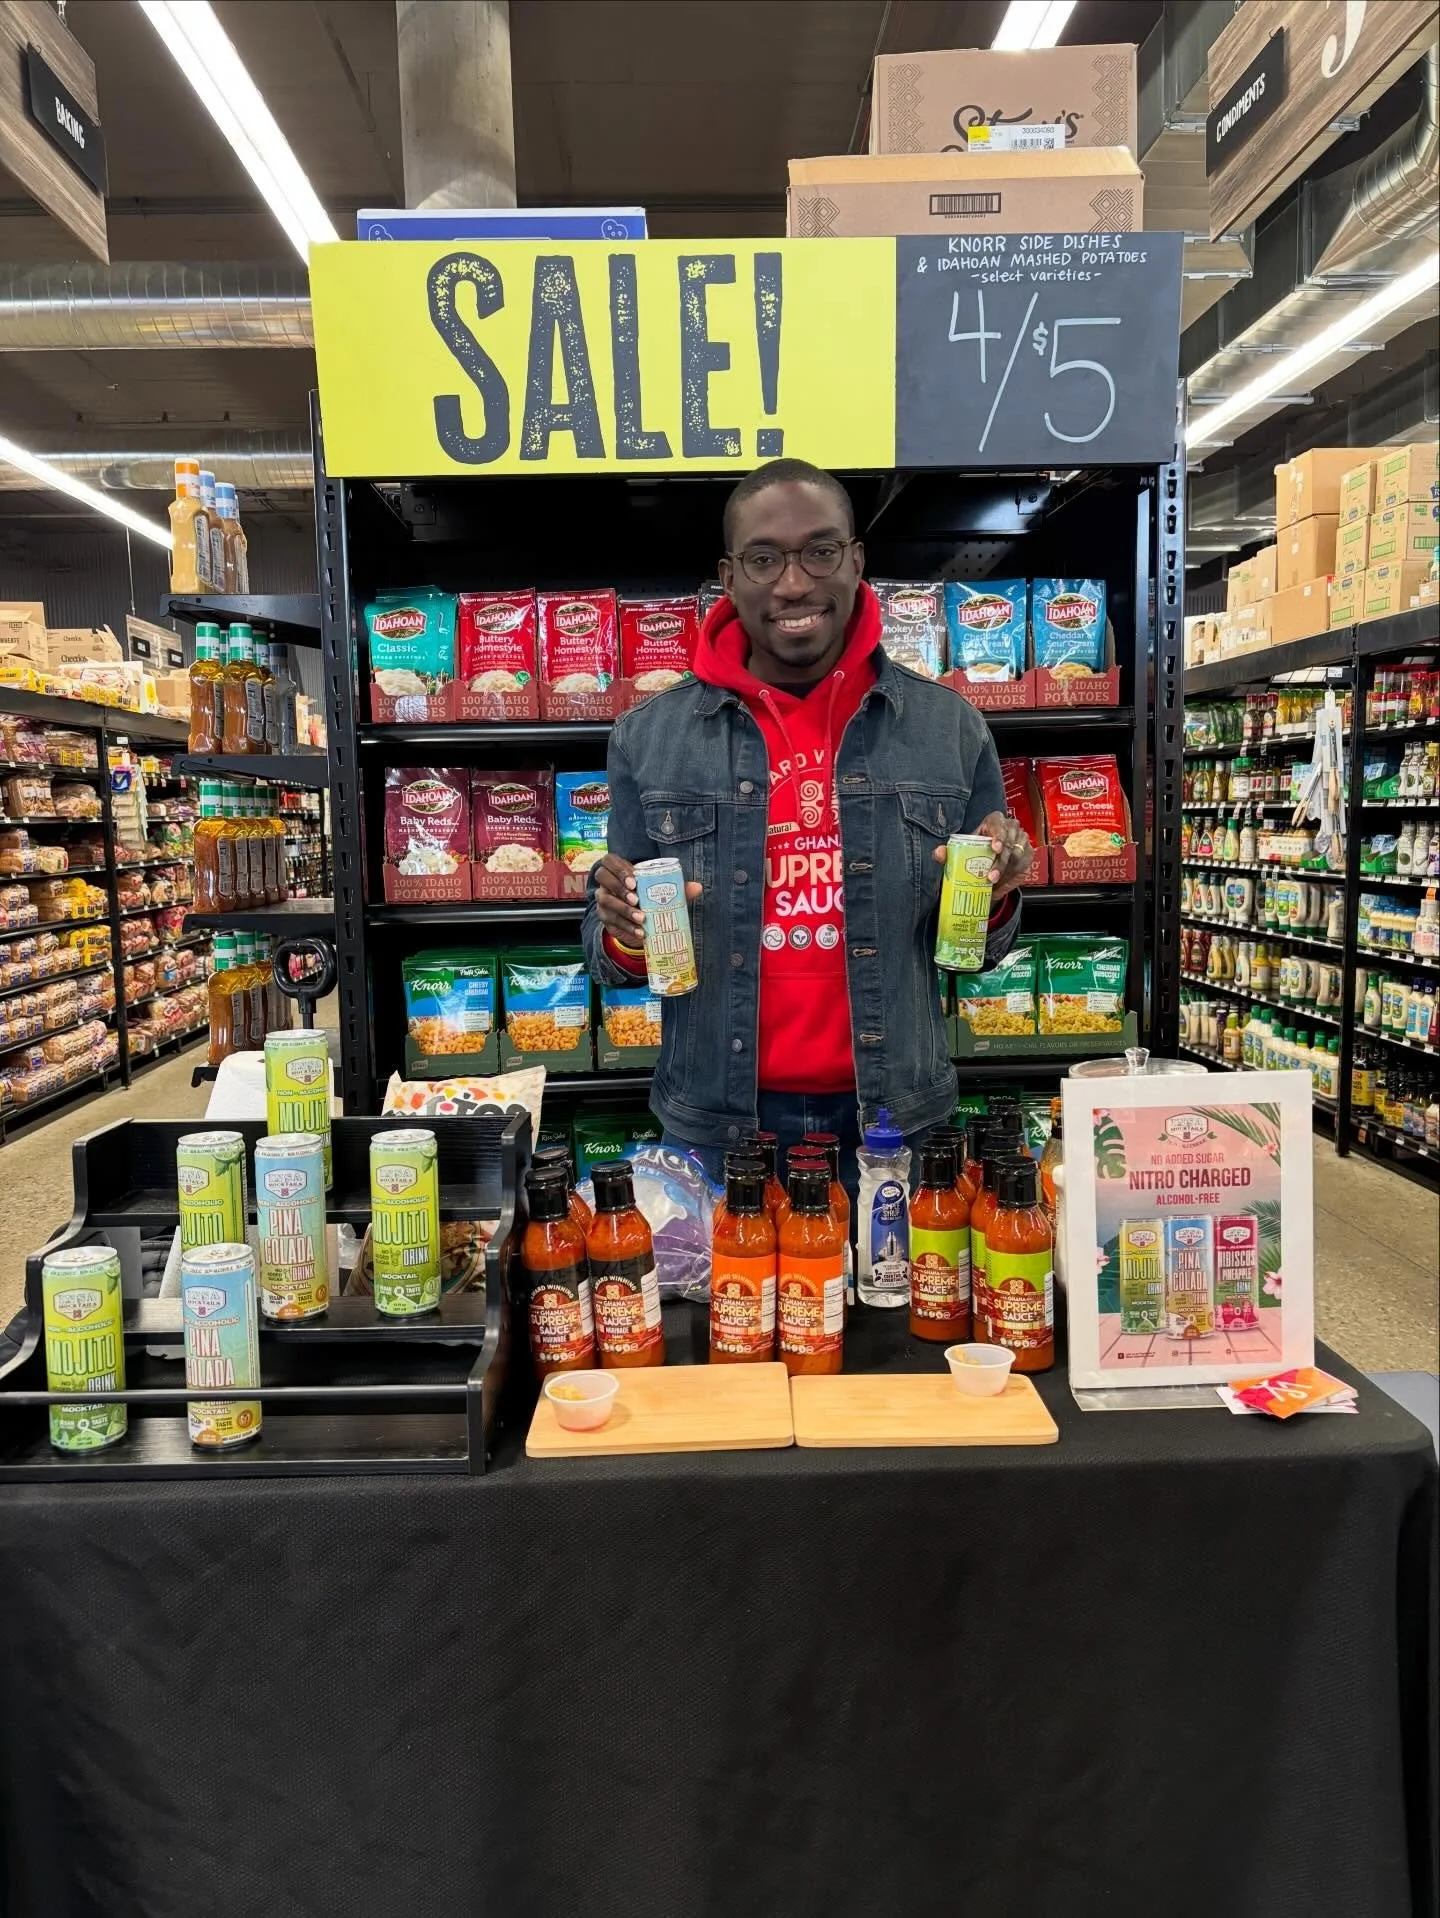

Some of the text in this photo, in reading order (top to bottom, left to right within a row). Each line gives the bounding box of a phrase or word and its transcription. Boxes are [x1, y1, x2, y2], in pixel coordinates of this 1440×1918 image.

[1216, 72, 1266, 144] CONDIMENTS
[54, 96, 85, 149] BAKING
[948, 234, 1122, 253] KNORR SIDE DISHES
[917, 251, 1148, 273] & IDAHOAN MASHED POTATOES
[427, 252, 784, 464] SALE!
[960, 604, 1010, 623] IDAHOAN
[1049, 603, 1095, 620] IDAHOAN
[375, 615, 424, 631] IDAHOAN
[556, 612, 598, 627] IDAHOAN
[639, 620, 683, 632] IDAHOAN
[479, 634, 515, 645] Buttery
[560, 636, 595, 646] Buttery
[1050, 631, 1085, 640] Cheddar
[377, 643, 417, 653] Classic
[473, 643, 523, 653] Homestyle
[554, 644, 603, 655] Homestyle
[643, 639, 679, 648] Buttery
[636, 646, 687, 655] Homestyle
[61, 655, 87, 663] Cheerios
[961, 684, 1026, 694] 100% IDAHO
[1074, 681, 1110, 690] IDAHO
[1044, 691, 1110, 703] POTATOES
[461, 705, 530, 718] POTATOES
[546, 705, 613, 718] POTATOES
[768, 752, 808, 786] ARD
[1062, 777, 1106, 792] IDAHOAN
[405, 790, 450, 804] IDAHOAN
[491, 792, 534, 805] IDAHOAN
[1057, 803, 1079, 811] Four
[400, 816, 452, 827] Baby Reds
[487, 815, 538, 826] Baby Reds
[767, 822, 792, 835] atural
[794, 836, 844, 851] GHAN
[1092, 858, 1127, 868] IDAHO
[481, 876, 548, 886] 100% IDAHO
[1061, 868, 1127, 881] POTATOES
[393, 878, 462, 889] 100% IDAHO
[394, 888, 462, 899] POTATOES
[481, 885, 548, 897] POTATOES
[653, 911, 679, 935] PINA
[1045, 957, 1084, 970] Knorr
[411, 979, 452, 992] Knorr
[954, 1106, 981, 1114] norr
[583, 1142, 623, 1154] Knorr
[1151, 1152, 1225, 1165] NO ADDED SUGAR
[1129, 1167, 1251, 1190] NITRO CHARGED
[1156, 1192, 1221, 1206] ALCOHOL-FREE
[269, 1209, 303, 1237] PINA
[373, 1208, 429, 1246] MOJITO
[264, 1236, 315, 1266] COLADA
[402, 1245, 429, 1268] DRINK
[1178, 1251, 1200, 1270] PINA
[1217, 1249, 1257, 1269] HIBISCUS
[292, 1265, 315, 1281] DRINK
[912, 1271, 956, 1286] SUPREME
[1221, 1267, 1251, 1281] PINEAPPLE
[609, 1275, 637, 1291] WINNING
[1172, 1271, 1208, 1292] COLADA
[919, 1285, 947, 1294] SAUCE
[722, 1298, 746, 1307] GHANA
[779, 1301, 821, 1317] SUPREME
[785, 1298, 807, 1307] GHANA
[993, 1299, 1043, 1313] SUPREME
[596, 1304, 641, 1318] SUPREME
[713, 1302, 759, 1317] SUPREME
[1003, 1311, 1034, 1321] SAUCE
[530, 1314, 578, 1327] SUPREME
[602, 1316, 633, 1326] SAUCE
[719, 1316, 750, 1327] SAUCE
[783, 1316, 812, 1327] SAUCE
[539, 1325, 570, 1335] SAUCE
[189, 1327, 221, 1358] PINA
[49, 1333, 116, 1376] MOJITO
[187, 1356, 236, 1388] COLADA
[87, 1370, 116, 1393] DRINK
[61, 1403, 105, 1413] MOCKTAIL
